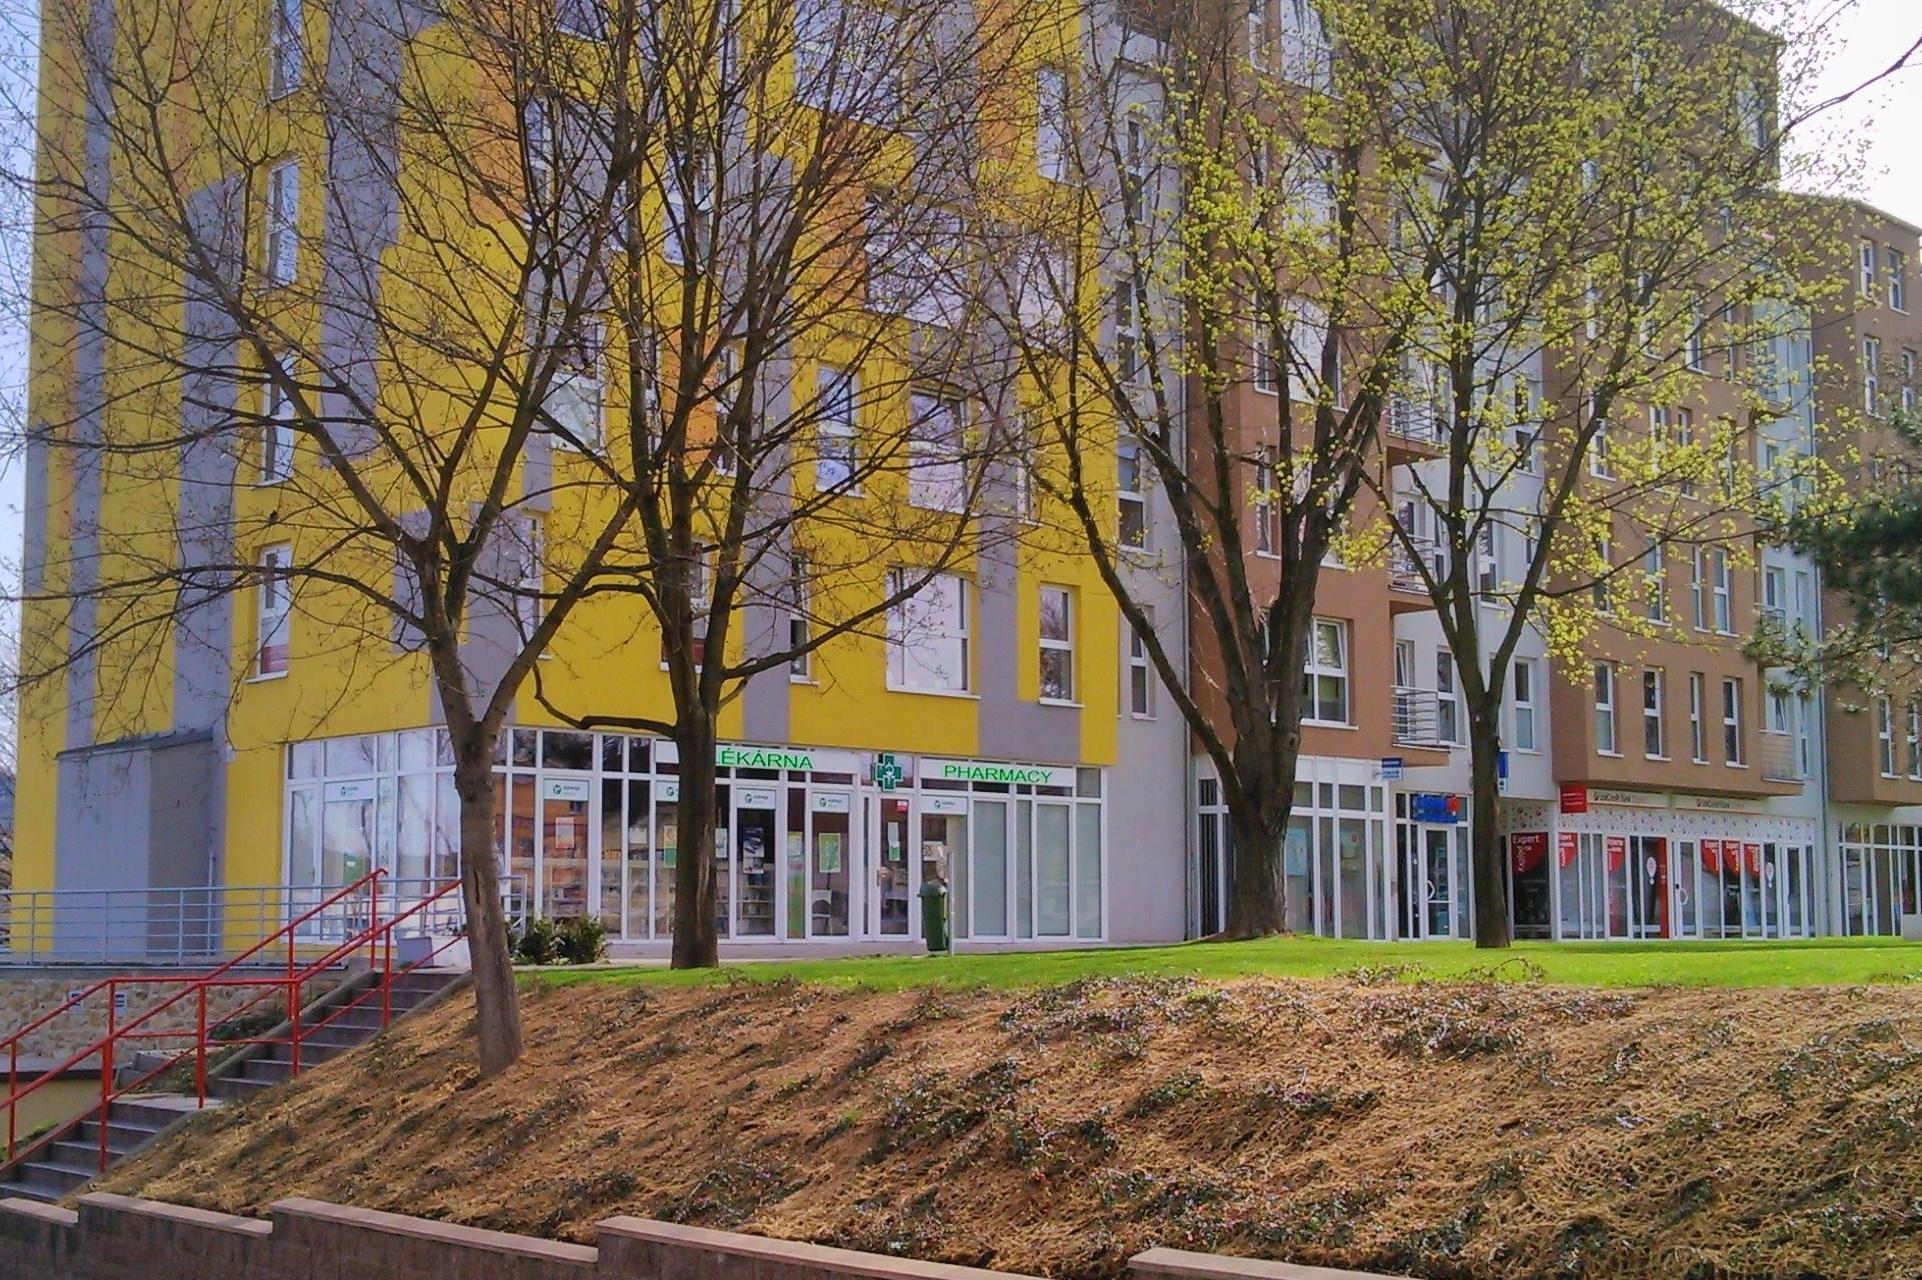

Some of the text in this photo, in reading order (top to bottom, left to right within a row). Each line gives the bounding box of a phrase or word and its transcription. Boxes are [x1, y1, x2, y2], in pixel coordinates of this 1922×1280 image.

[715, 747, 813, 769] ÉKÁRNA
[944, 765, 1052, 783] PHARMACY
[1512, 834, 1540, 846] Expert
